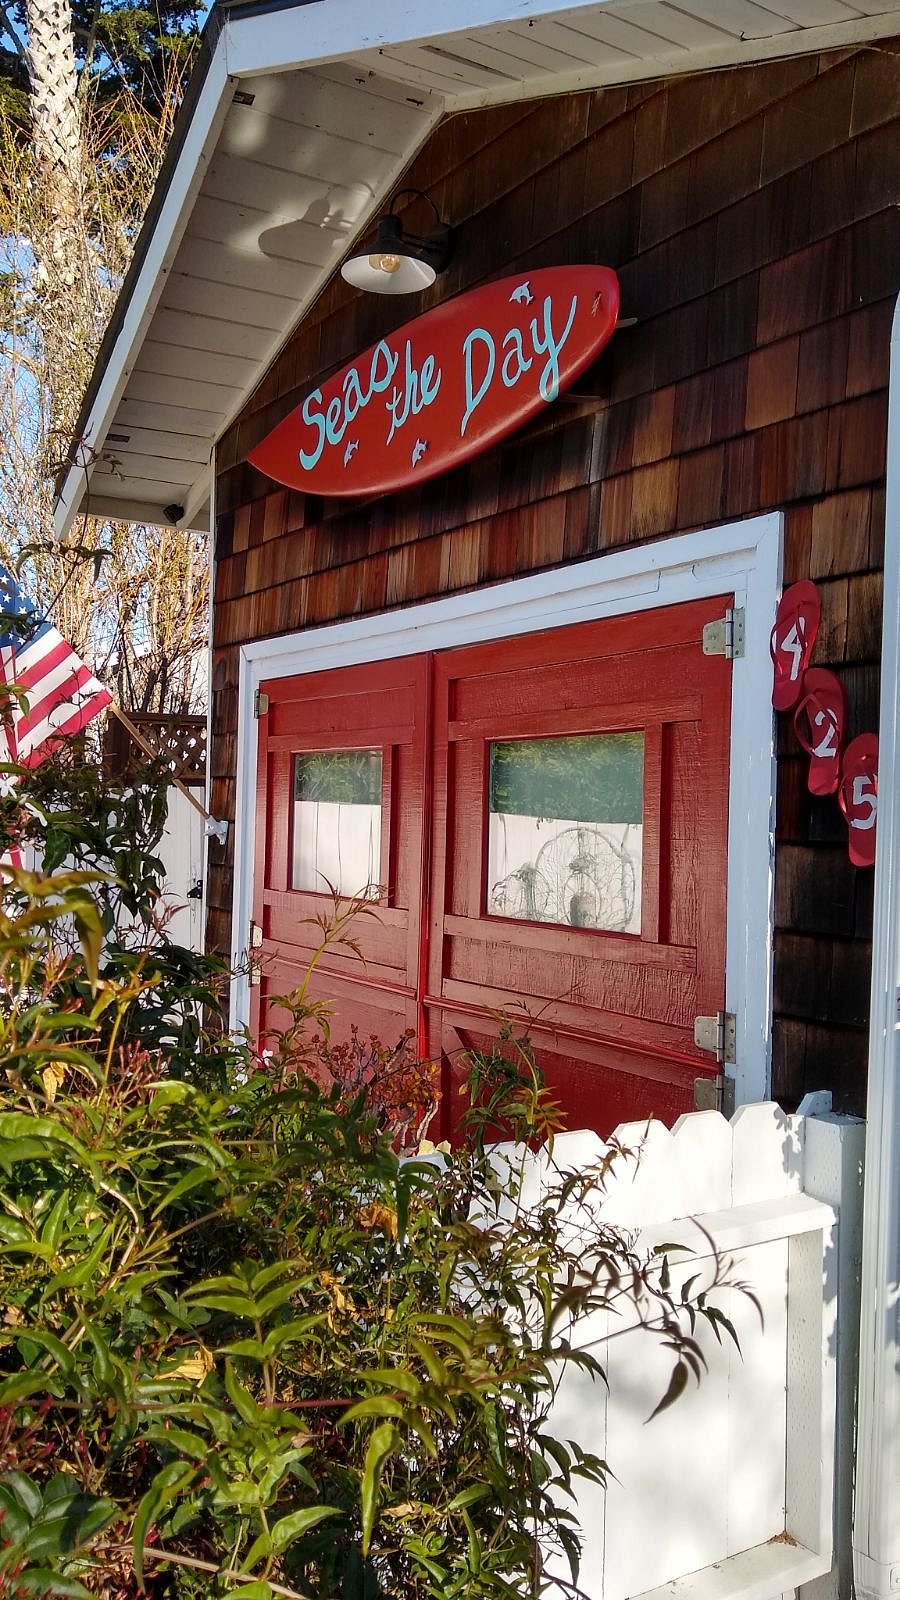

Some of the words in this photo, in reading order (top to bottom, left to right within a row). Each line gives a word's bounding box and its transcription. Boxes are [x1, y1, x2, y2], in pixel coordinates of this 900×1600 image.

[299, 339, 398, 470] Seas
[385, 340, 442, 446] the
[461, 296, 578, 437] Day
[780, 616, 806, 681] 4
[812, 708, 838, 758] 2
[850, 775, 878, 830] 5
